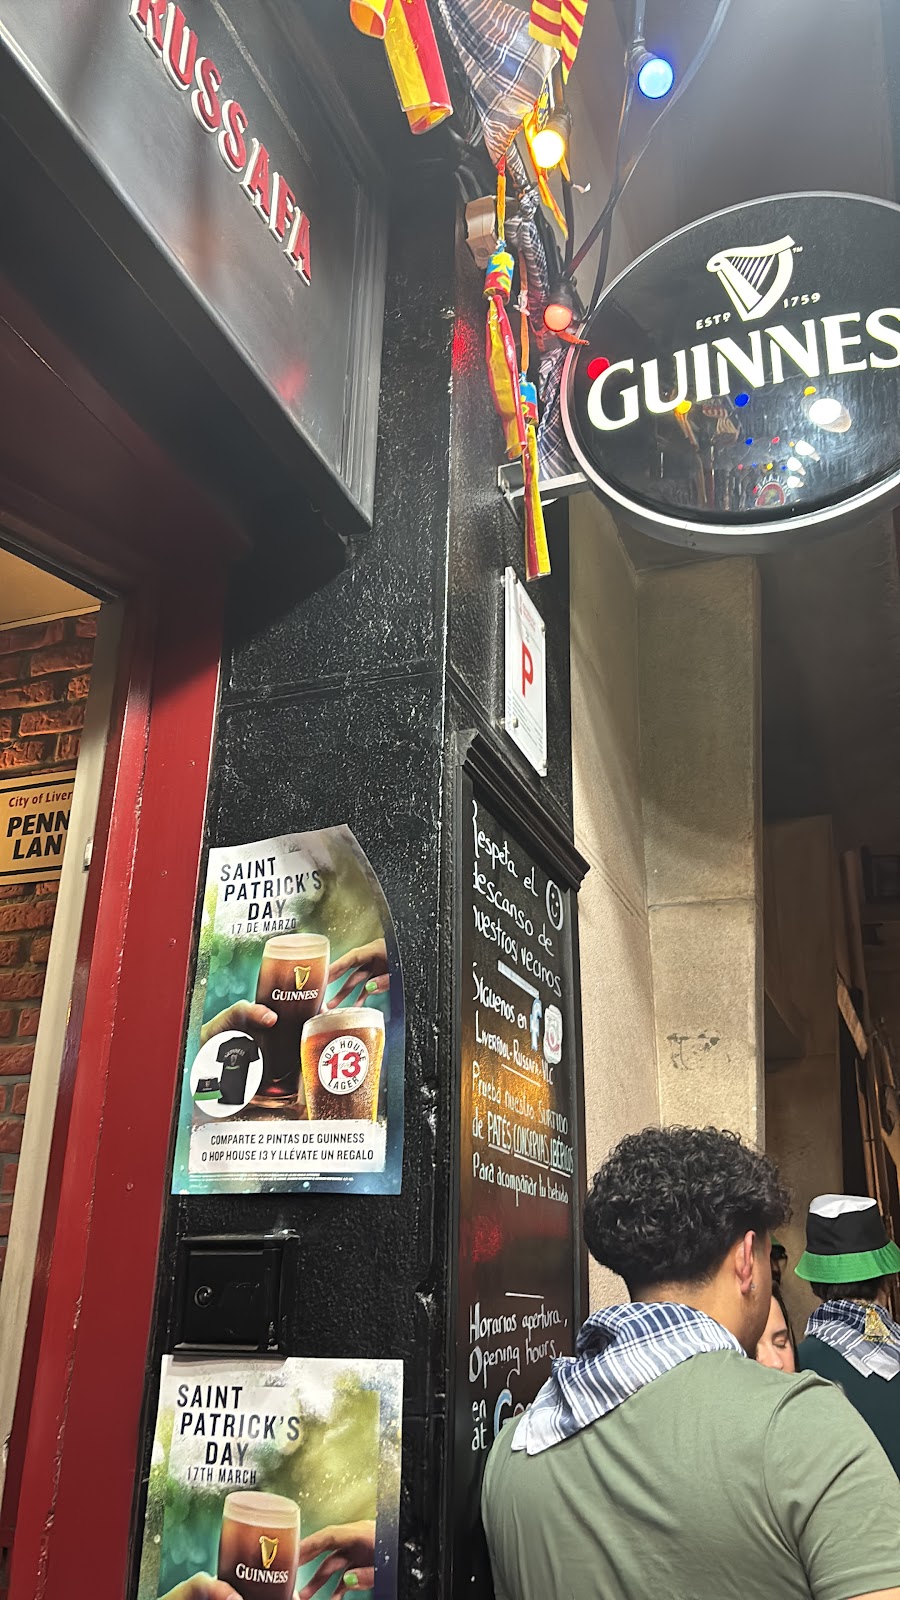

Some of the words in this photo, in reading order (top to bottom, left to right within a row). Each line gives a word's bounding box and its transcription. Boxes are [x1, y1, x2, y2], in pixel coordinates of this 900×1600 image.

[782, 292, 821, 309] 1759
[521, 640, 534, 698] P
[8, 796, 29, 808] City
[32, 792, 44, 804] of
[45, 790, 73, 803] Liver
[6, 809, 71, 837] PENN
[220, 856, 276, 882] SAINT
[523, 866, 538, 897] el
[223, 870, 322, 902] PATRICK'S
[247, 898, 286, 920] DAY
[231, 923, 242, 935] 17
[246, 921, 258, 933] DE
[262, 918, 297, 932] MARZO
[538, 922, 554, 957] de
[271, 988, 319, 1001] GUINNESS
[517, 1012, 527, 1030] en
[322, 1045, 336, 1067] HOP
[340, 1040, 367, 1062] HOUSE
[327, 1051, 361, 1079] 13
[328, 1077, 359, 1090] LAGER
[472, 1106, 484, 1140] de
[210, 1134, 256, 1146] COMPARTE
[258, 1134, 264, 1144] 2
[266, 1133, 300, 1144] PINTAS
[302, 1133, 314, 1144] DE
[316, 1133, 365, 1144] GUINNESS
[201, 1151, 207, 1162] O
[209, 1151, 224, 1162] HOP
[225, 1150, 256, 1161] HOUSE
[258, 1150, 268, 1161] 13
[271, 1150, 277, 1160] Y
[278, 1148, 319, 1160] LLÉVATE
[320, 1150, 334, 1160] UN
[337, 1149, 374, 1160] REGALO
[472, 1151, 494, 1183] Para
[539, 1173, 546, 1198] tu
[469, 1302, 517, 1344] Horarios
[469, 1345, 520, 1389] Opening
[177, 1384, 243, 1409] SAINT
[472, 1399, 487, 1422] en
[180, 1412, 300, 1441] PATRICK'S
[471, 1422, 488, 1451] at
[205, 1441, 249, 1467] DAY
[187, 1467, 214, 1481] 17TH
[218, 1468, 257, 1486] MARCH
[235, 1562, 289, 1584] GUINNESS
